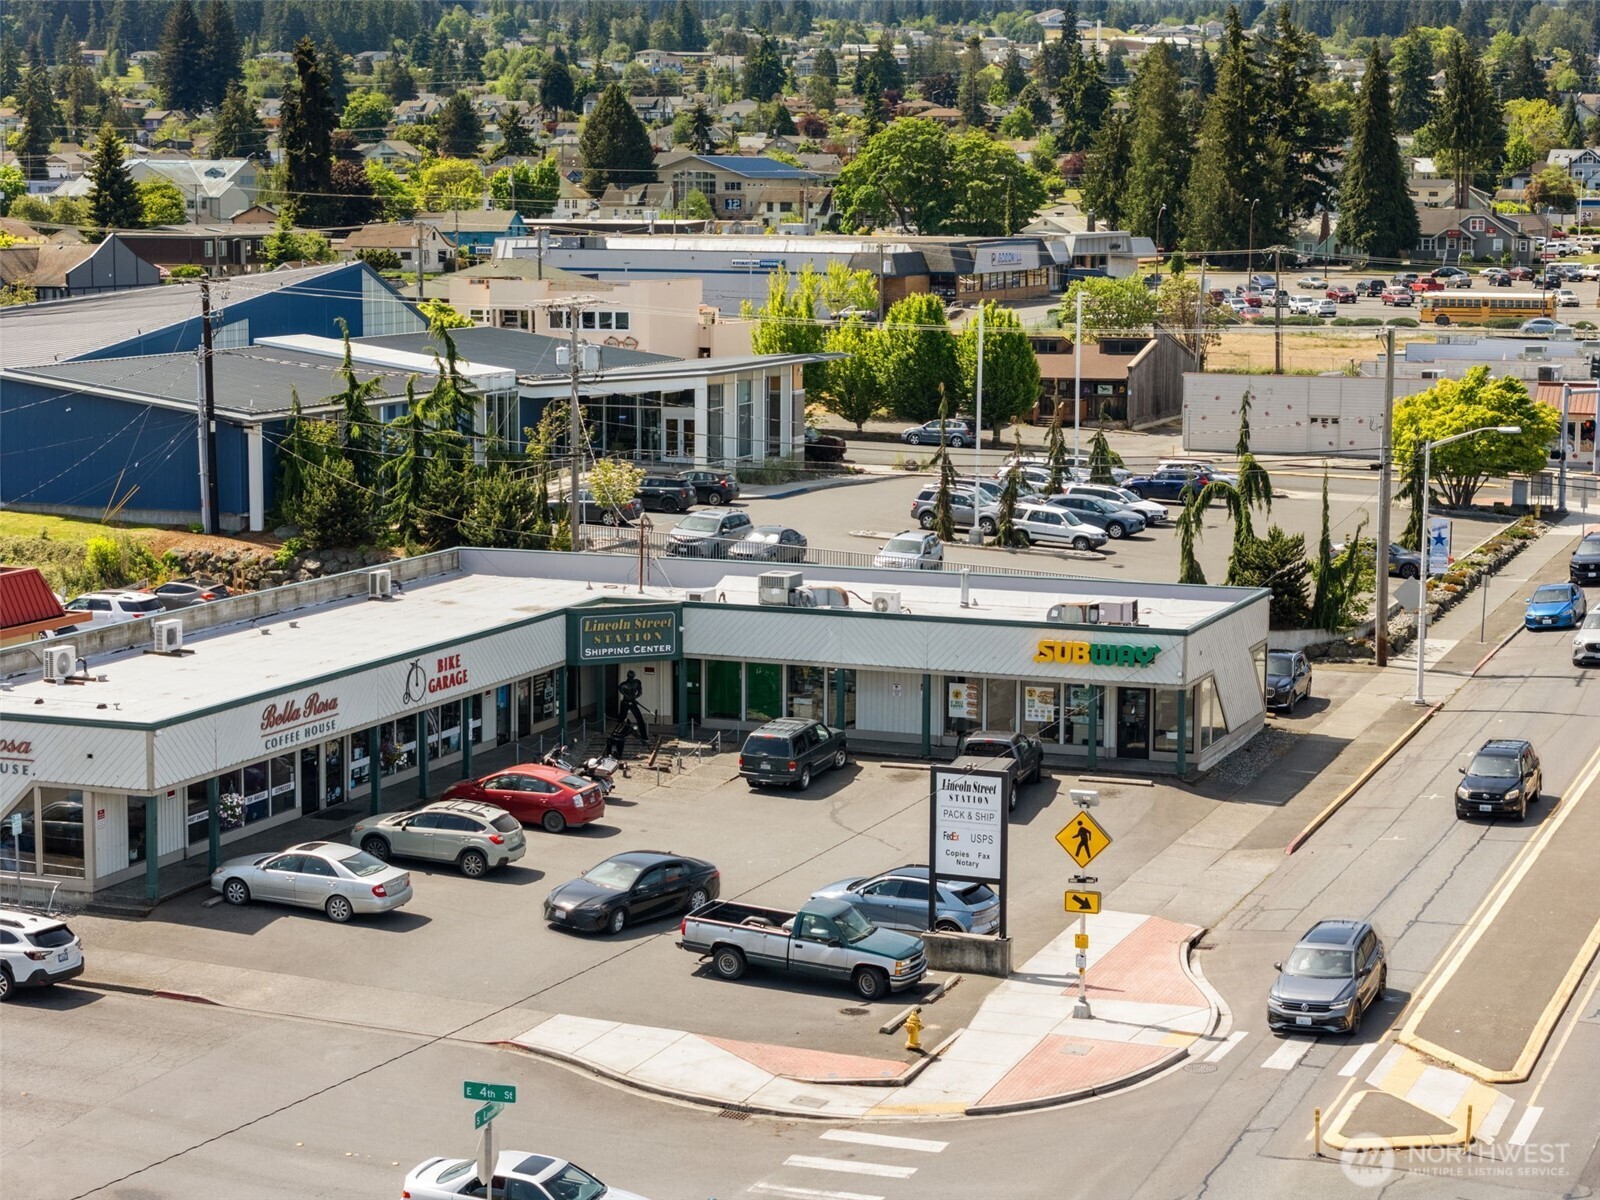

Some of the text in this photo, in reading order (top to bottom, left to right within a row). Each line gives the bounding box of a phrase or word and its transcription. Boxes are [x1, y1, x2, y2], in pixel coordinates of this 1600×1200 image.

[727, 199, 741, 210] 12
[584, 616, 673, 632] Lincoln Street
[593, 631, 662, 644] STATION
[1033, 639, 1162, 668] SUBWAY
[437, 653, 461, 674] BIKE
[428, 669, 468, 693] GARAGE
[260, 692, 338, 730] Bella Rosa
[264, 719, 336, 750] COFFEE HOUSE
[942, 778, 997, 795] Lincoln Street
[948, 793, 989, 805] STATION
[943, 808, 995, 822] PACK & SHIP
[942, 830, 994, 845] FedEx USPS
[945, 849, 991, 860] Copies Fax
[955, 859, 980, 869] Notary
[466, 1086, 513, 1100] E 4th St
[476, 1116, 481, 1125] S
